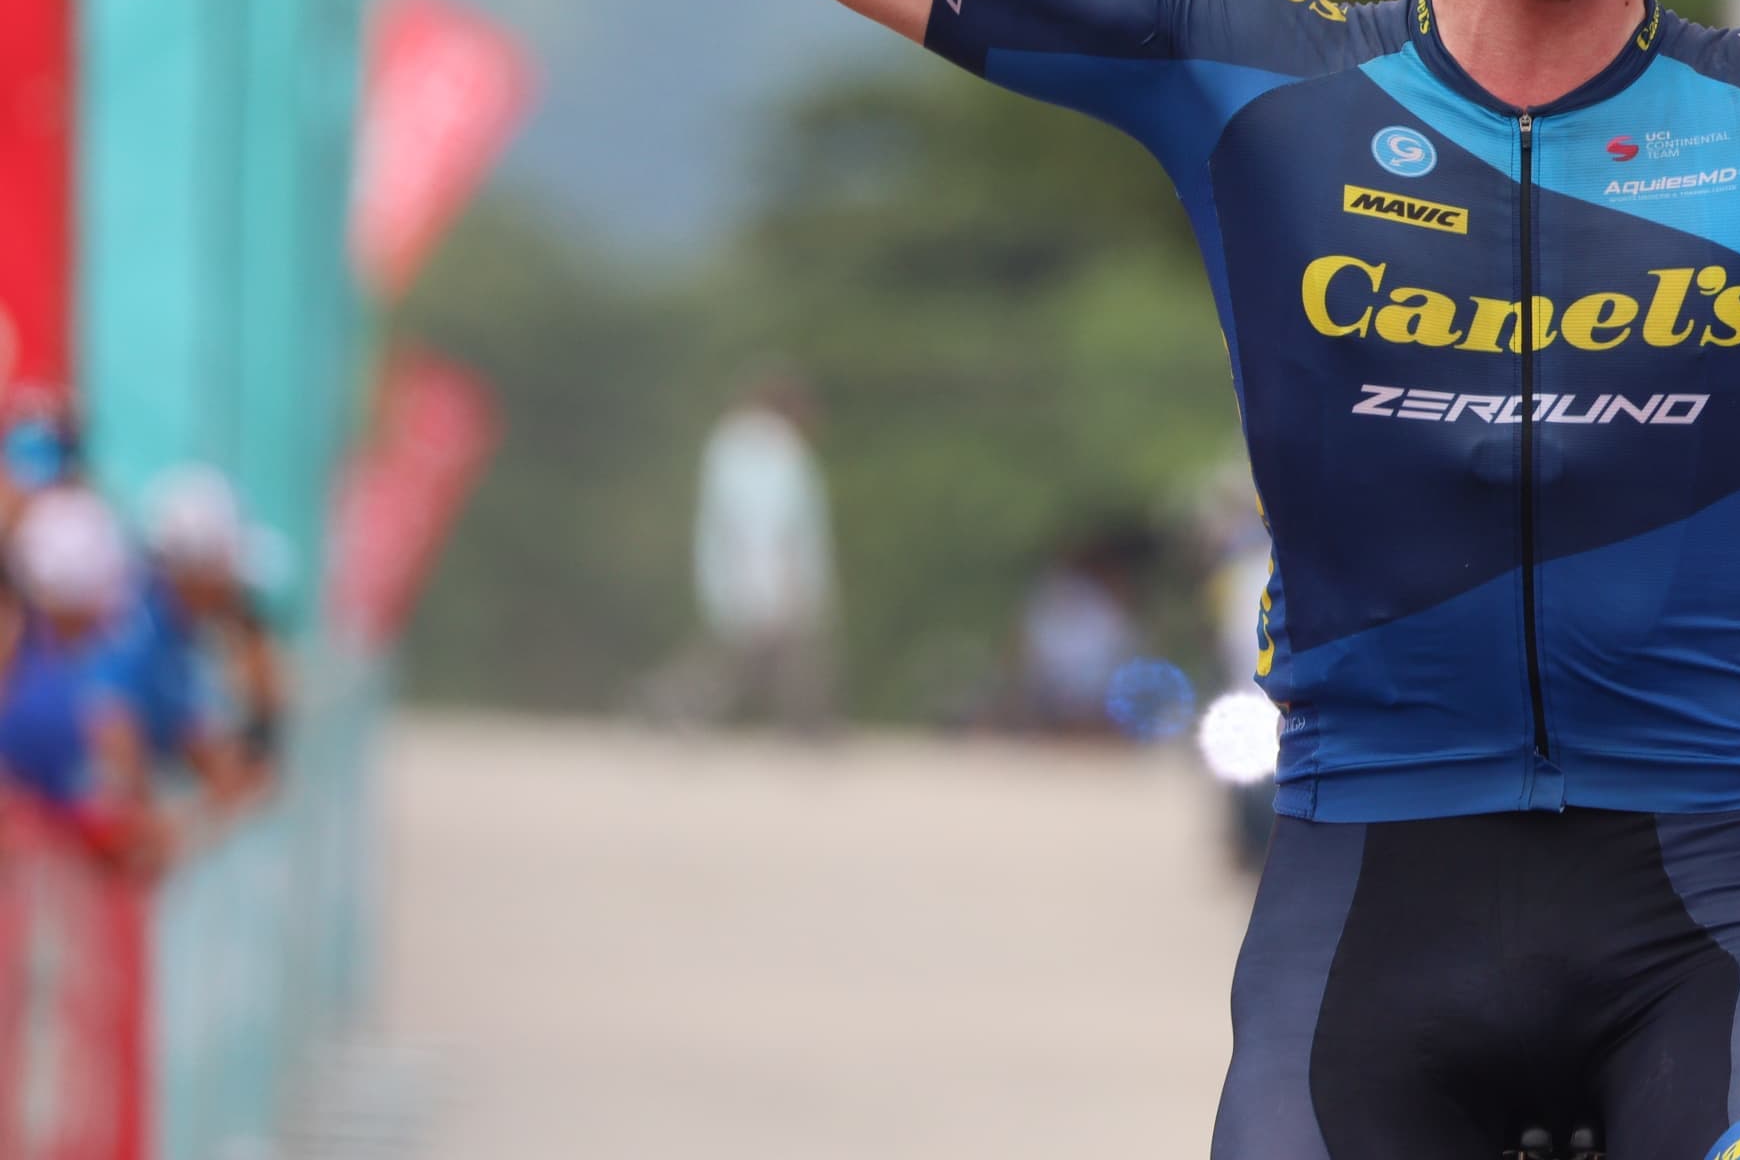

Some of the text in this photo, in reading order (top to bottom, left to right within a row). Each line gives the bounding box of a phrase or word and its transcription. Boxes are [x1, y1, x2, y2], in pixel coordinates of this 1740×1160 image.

[1645, 131, 1671, 142] UCI
[1646, 131, 1729, 151] CONTINENTAL
[1647, 148, 1680, 160] TEAM
[1351, 193, 1462, 228] MAVIC
[1351, 384, 1710, 426] ZEROUNO
